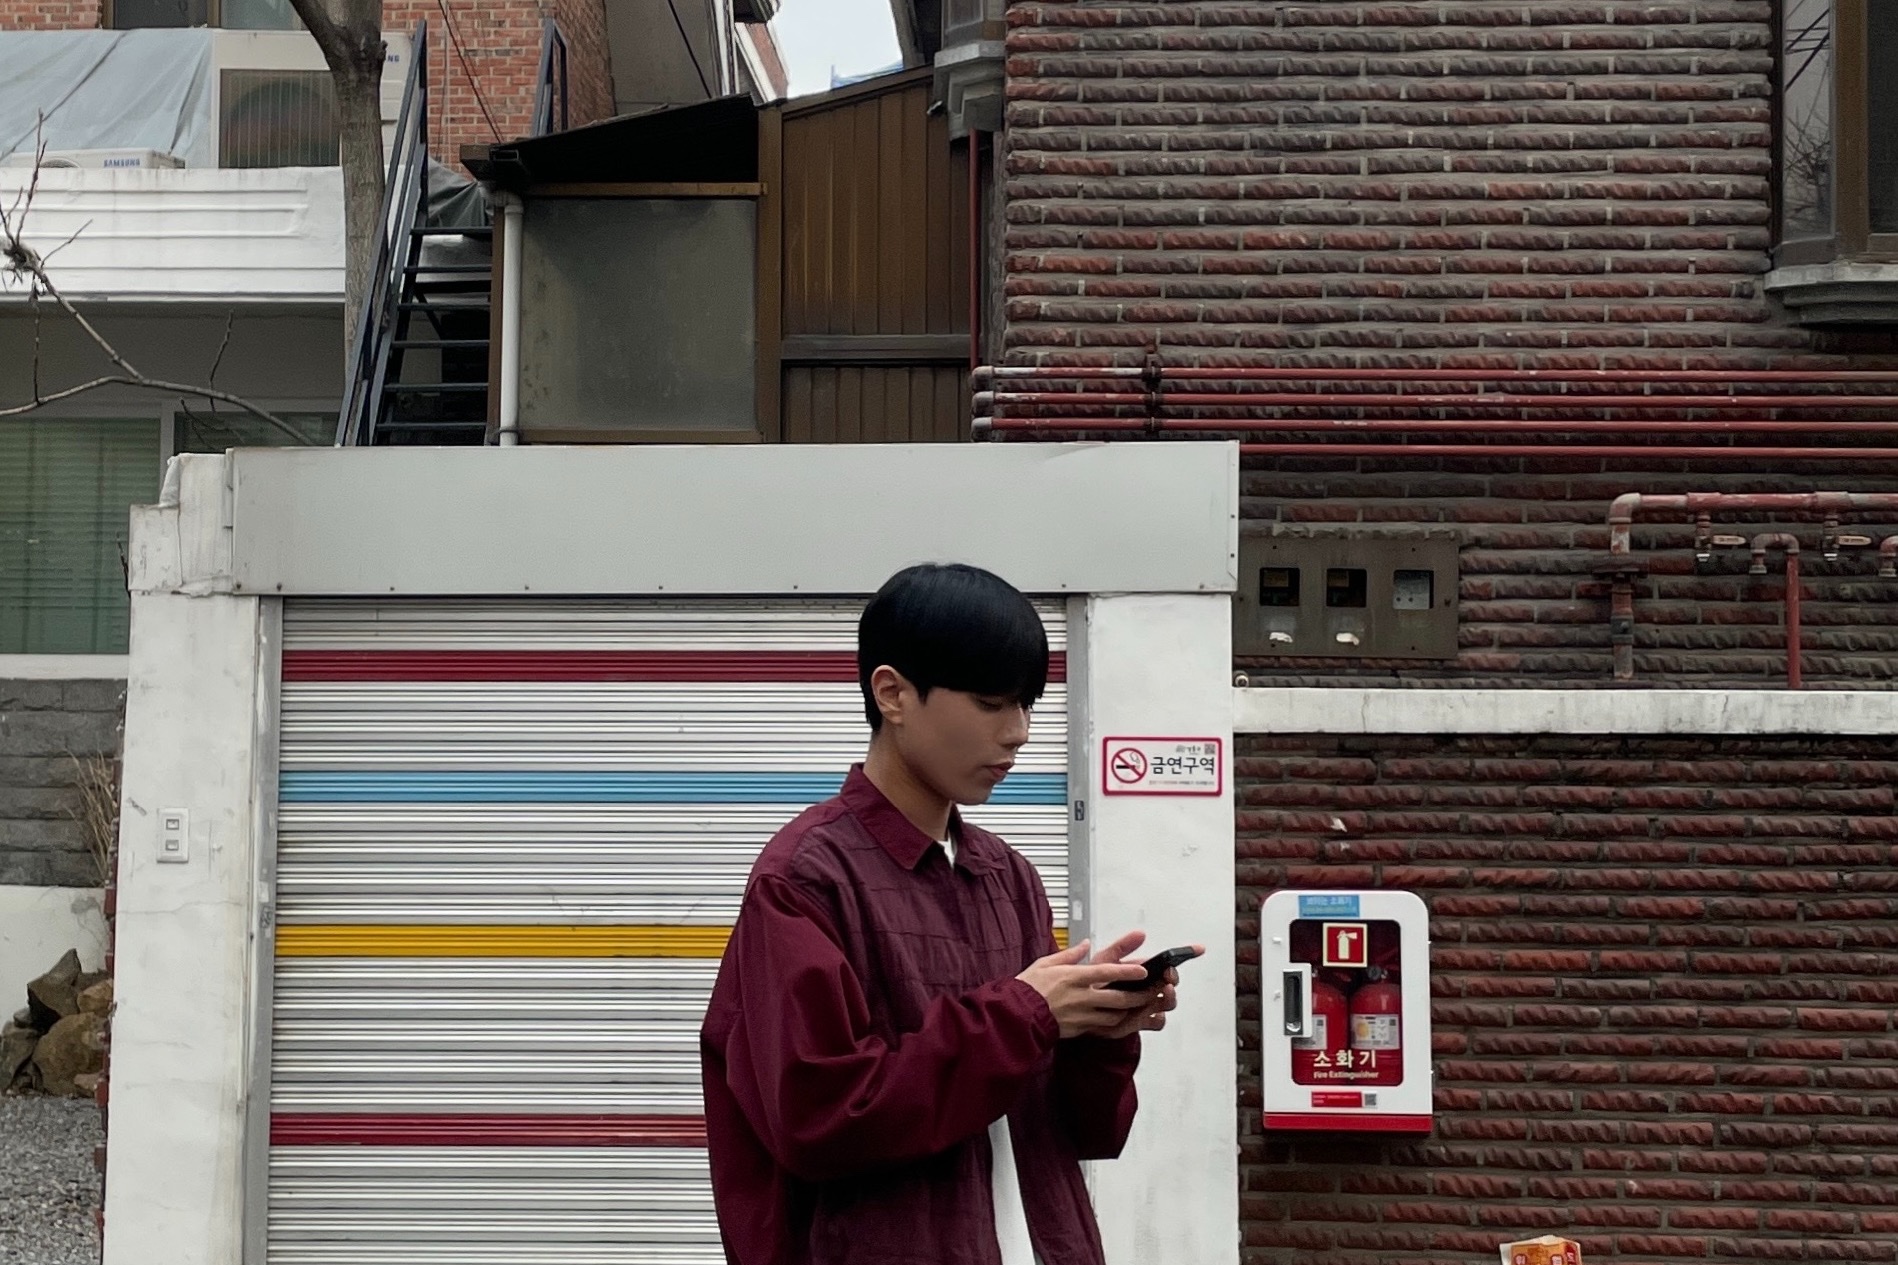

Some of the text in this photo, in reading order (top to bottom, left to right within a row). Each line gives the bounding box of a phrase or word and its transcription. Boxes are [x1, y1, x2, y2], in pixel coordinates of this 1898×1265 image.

[104, 158, 140, 167] SAMSUNG
[1151, 756, 1214, 776] 금연구역
[1313, 1049, 1376, 1068] 소화기
[1313, 1071, 1379, 1080] Fire Extinguisher
